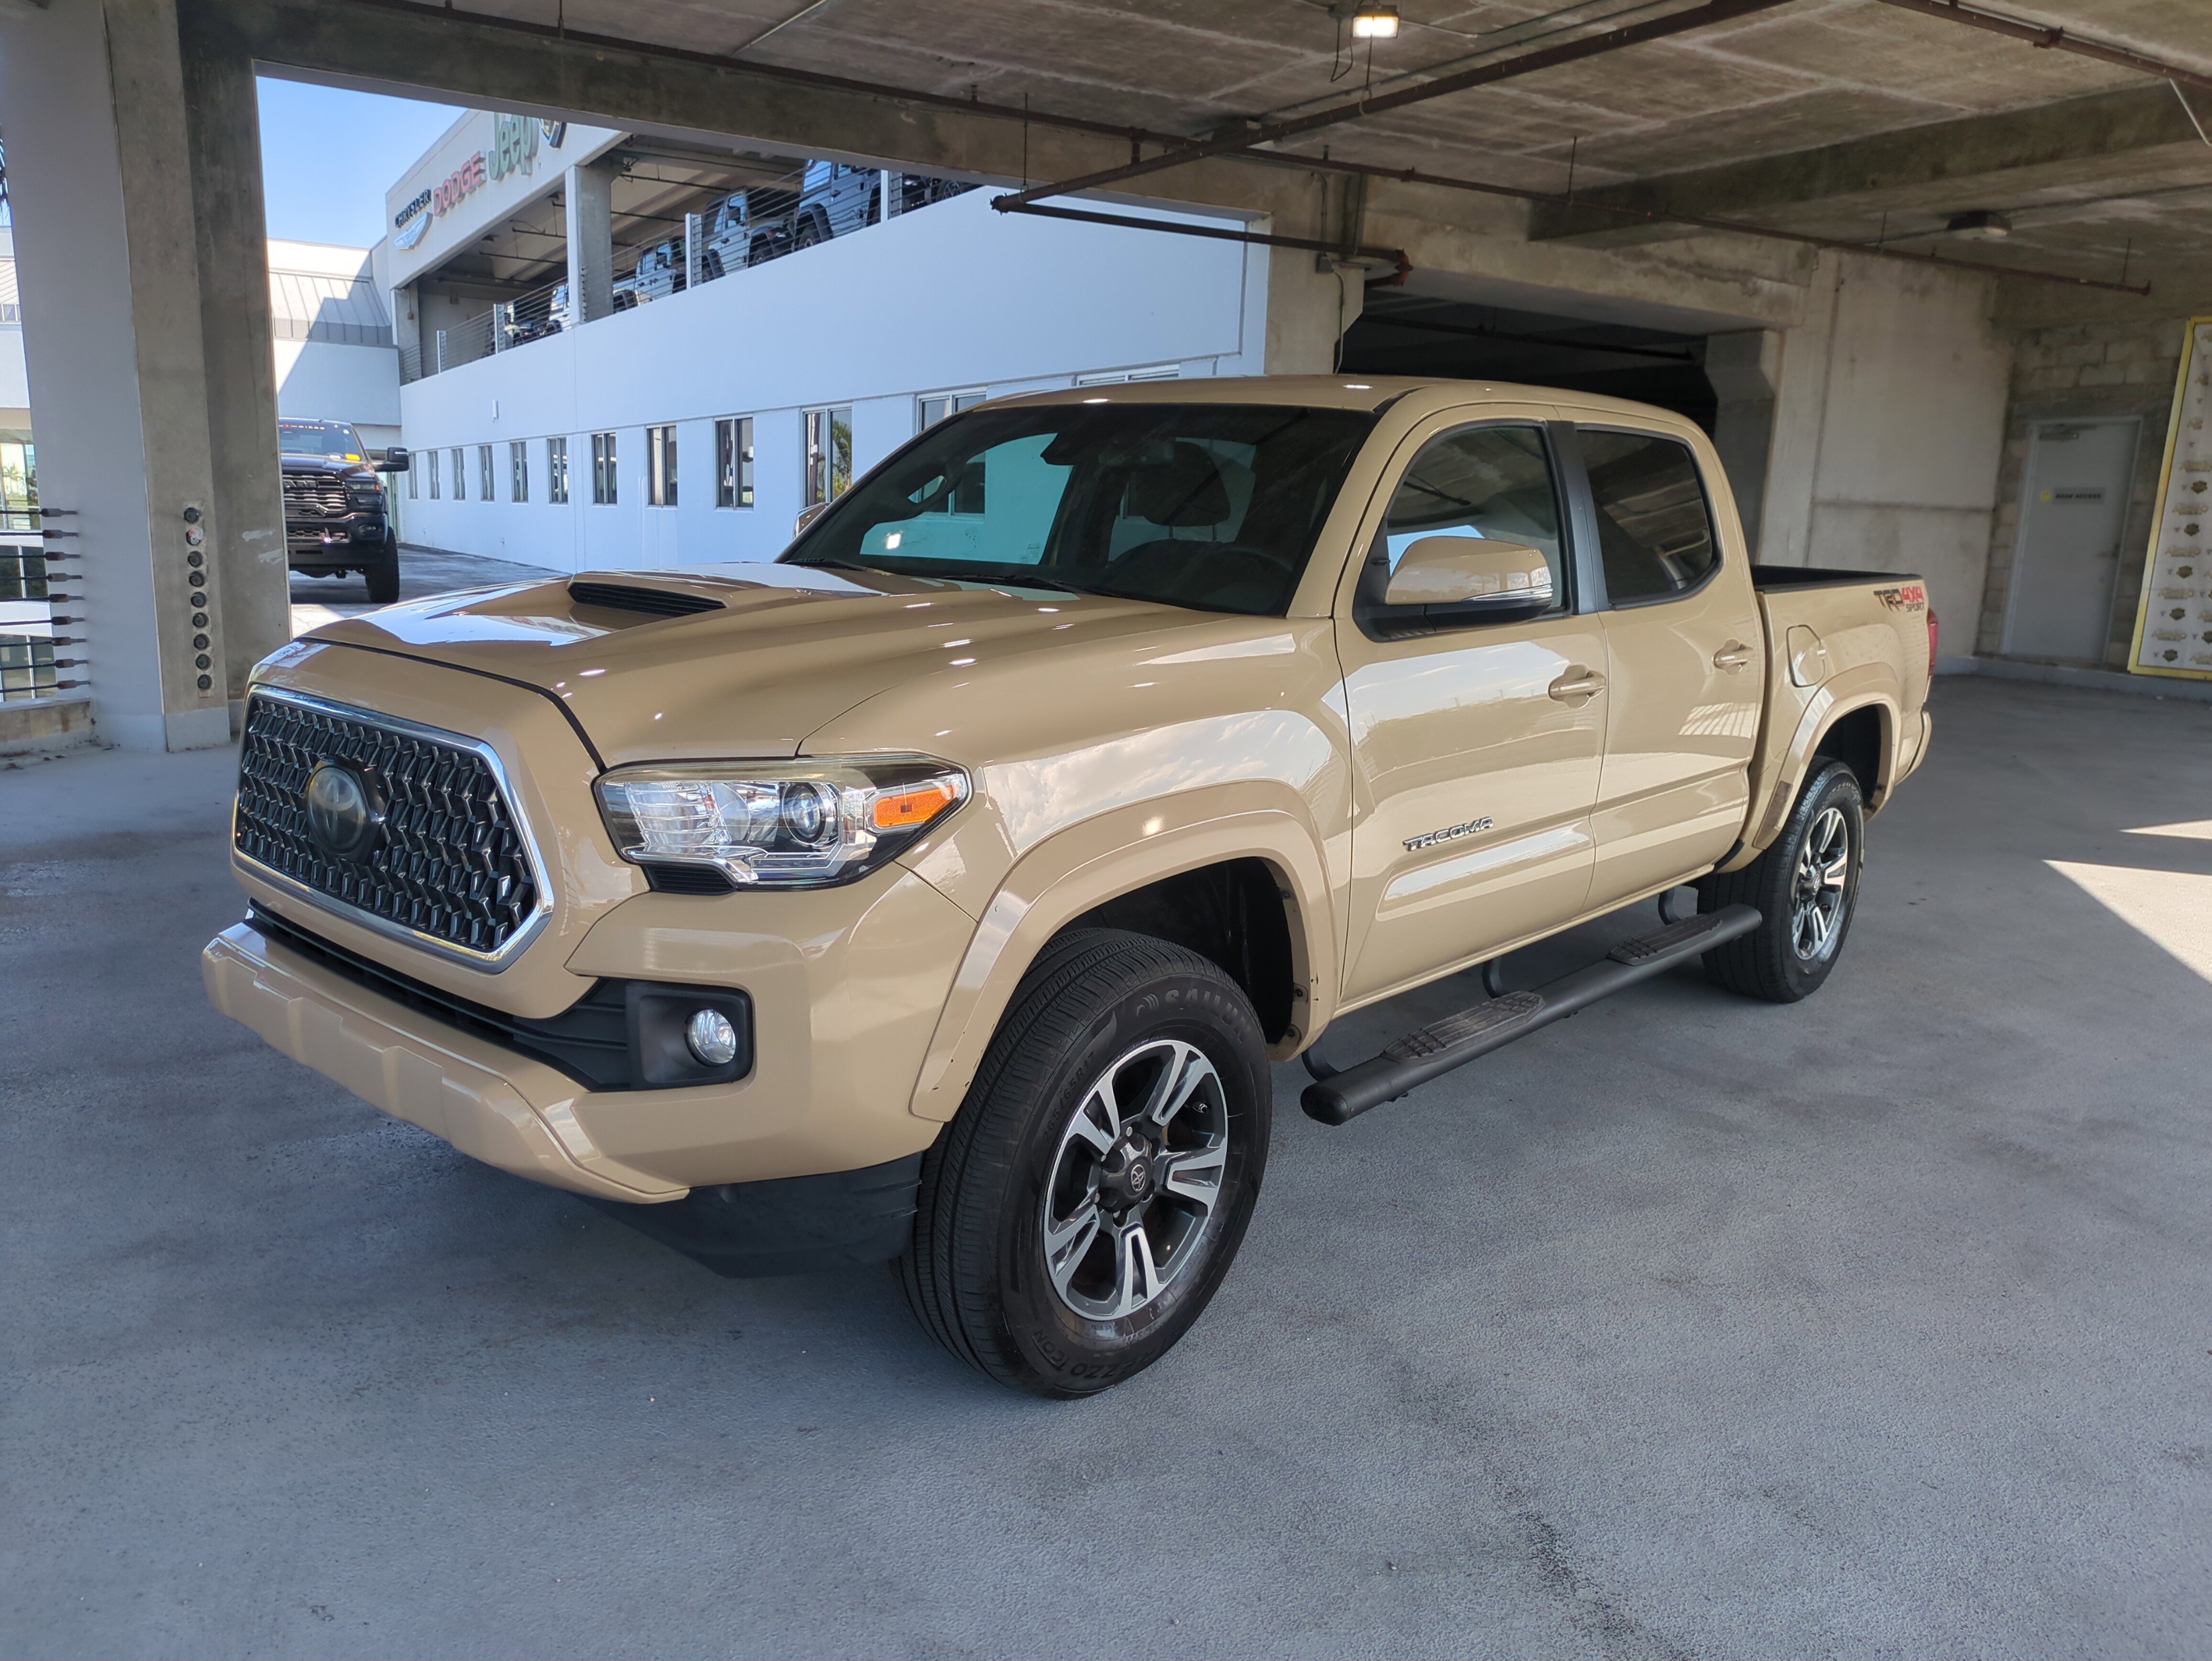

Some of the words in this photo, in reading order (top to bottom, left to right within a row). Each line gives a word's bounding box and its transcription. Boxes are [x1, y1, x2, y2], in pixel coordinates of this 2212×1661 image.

[488, 112, 539, 181] Jeep
[434, 151, 486, 216] DODGE
[1873, 588, 1905, 612] TRD
[1906, 602, 1924, 612] SPORT
[1403, 816, 1493, 851] TACOMA
[1165, 988, 1251, 1043] SAILUN
[1042, 1051, 1095, 1140] 265/65R17
